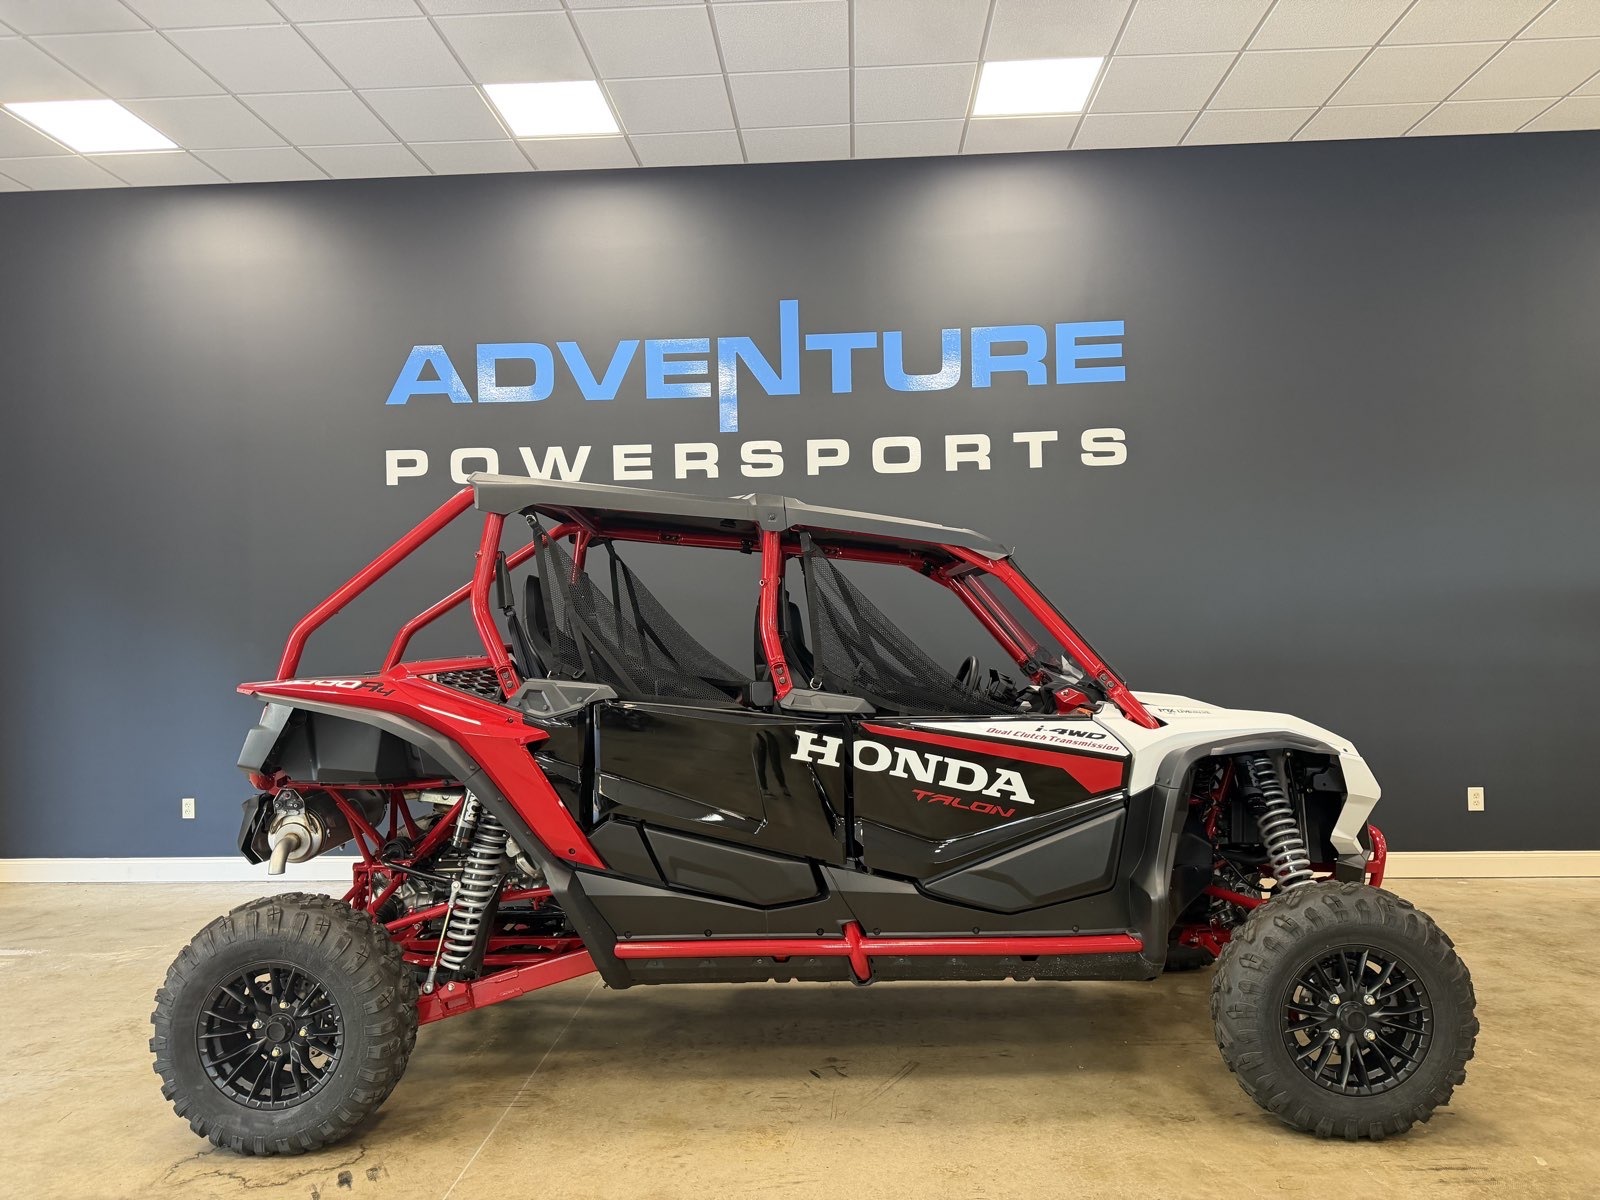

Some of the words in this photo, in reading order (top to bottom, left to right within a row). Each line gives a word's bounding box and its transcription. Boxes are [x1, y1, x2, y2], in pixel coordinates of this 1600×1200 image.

[385, 299, 1126, 433] ADVENTURE
[385, 427, 1128, 486] POWERSPORTS
[986, 727, 1010, 736] Dual
[1013, 731, 1047, 741] Clutch
[1049, 735, 1119, 752] Transmission
[1035, 725, 1107, 740] i-4WD
[790, 729, 1035, 805] HONDA
[912, 788, 1016, 818] TALON
